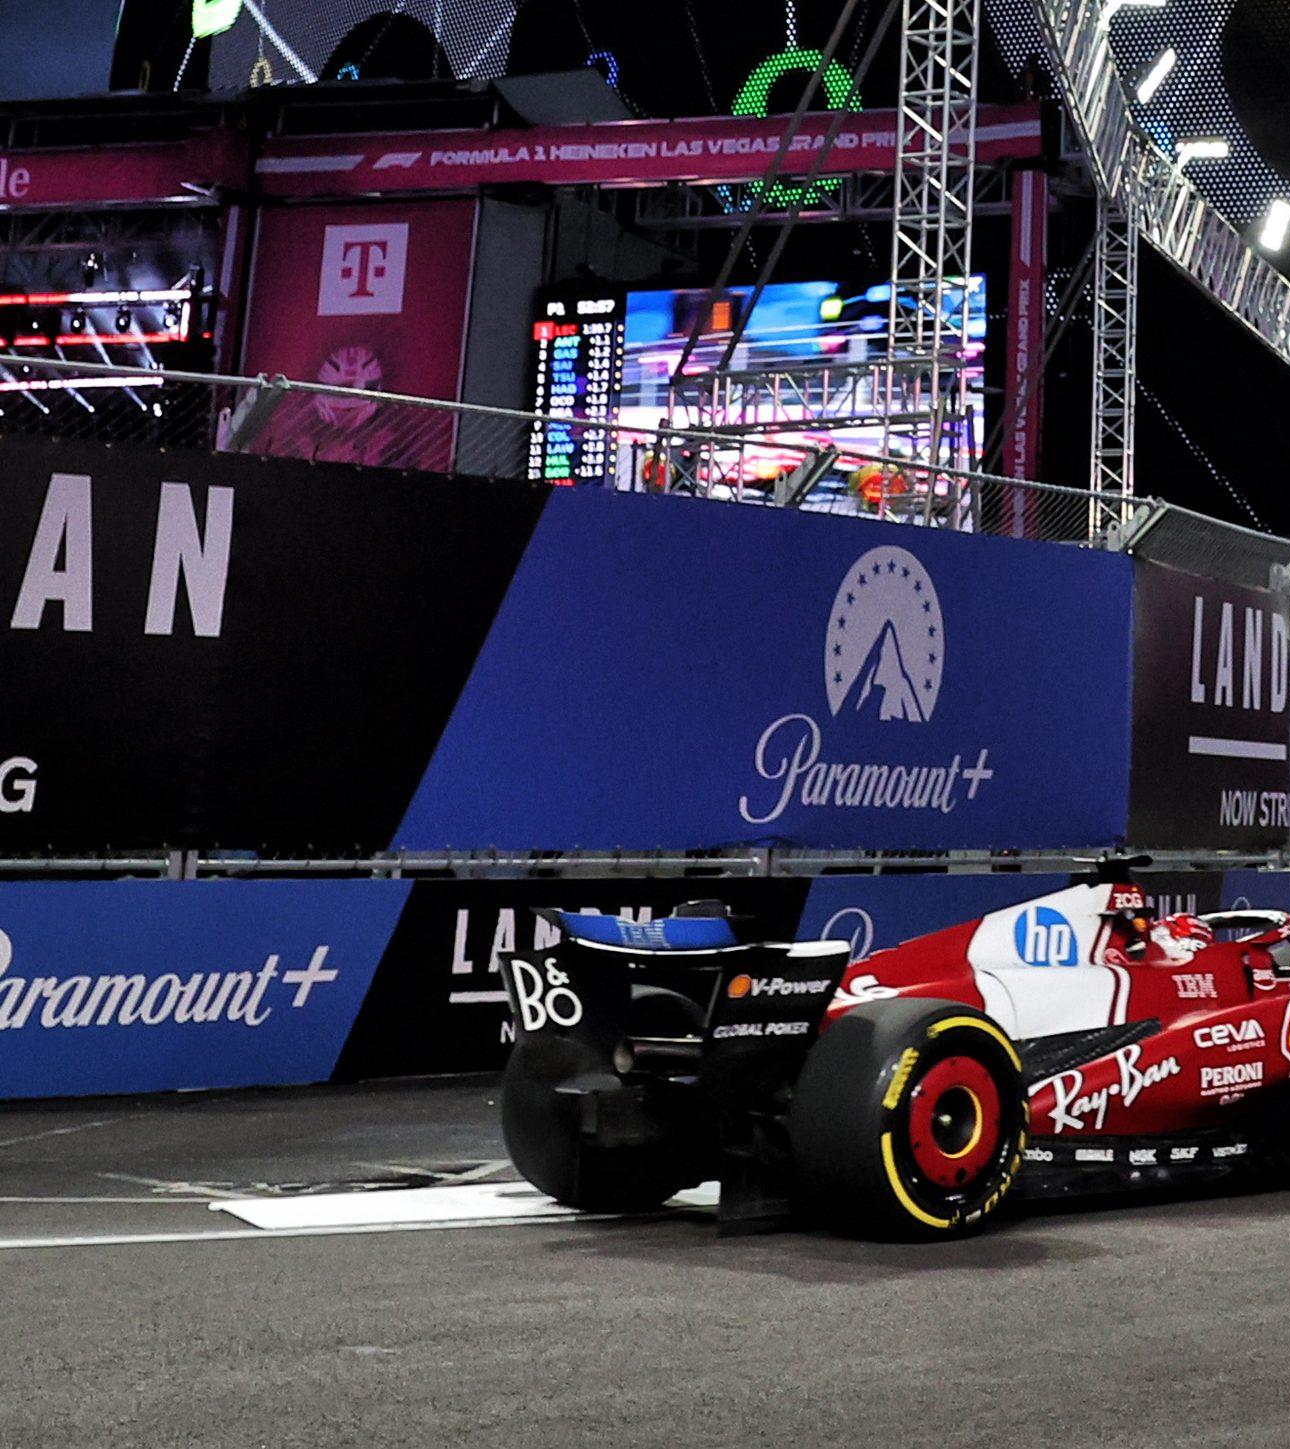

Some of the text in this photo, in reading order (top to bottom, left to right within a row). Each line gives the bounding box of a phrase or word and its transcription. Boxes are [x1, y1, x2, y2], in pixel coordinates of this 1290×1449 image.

[430, 146, 530, 166] FORMULA
[551, 142, 656, 160] HEINEKEN
[661, 140, 703, 157] LAS
[709, 137, 780, 156] VEGAS
[862, 131, 912, 149] PRI
[739, 714, 993, 824] Paramount+
[1219, 789, 1257, 827] NOW
[1024, 906, 1071, 967] hp
[751, 978, 831, 996] V-Power
[1171, 973, 1218, 998] IBM
[1200, 1062, 1263, 1088] PERONI
